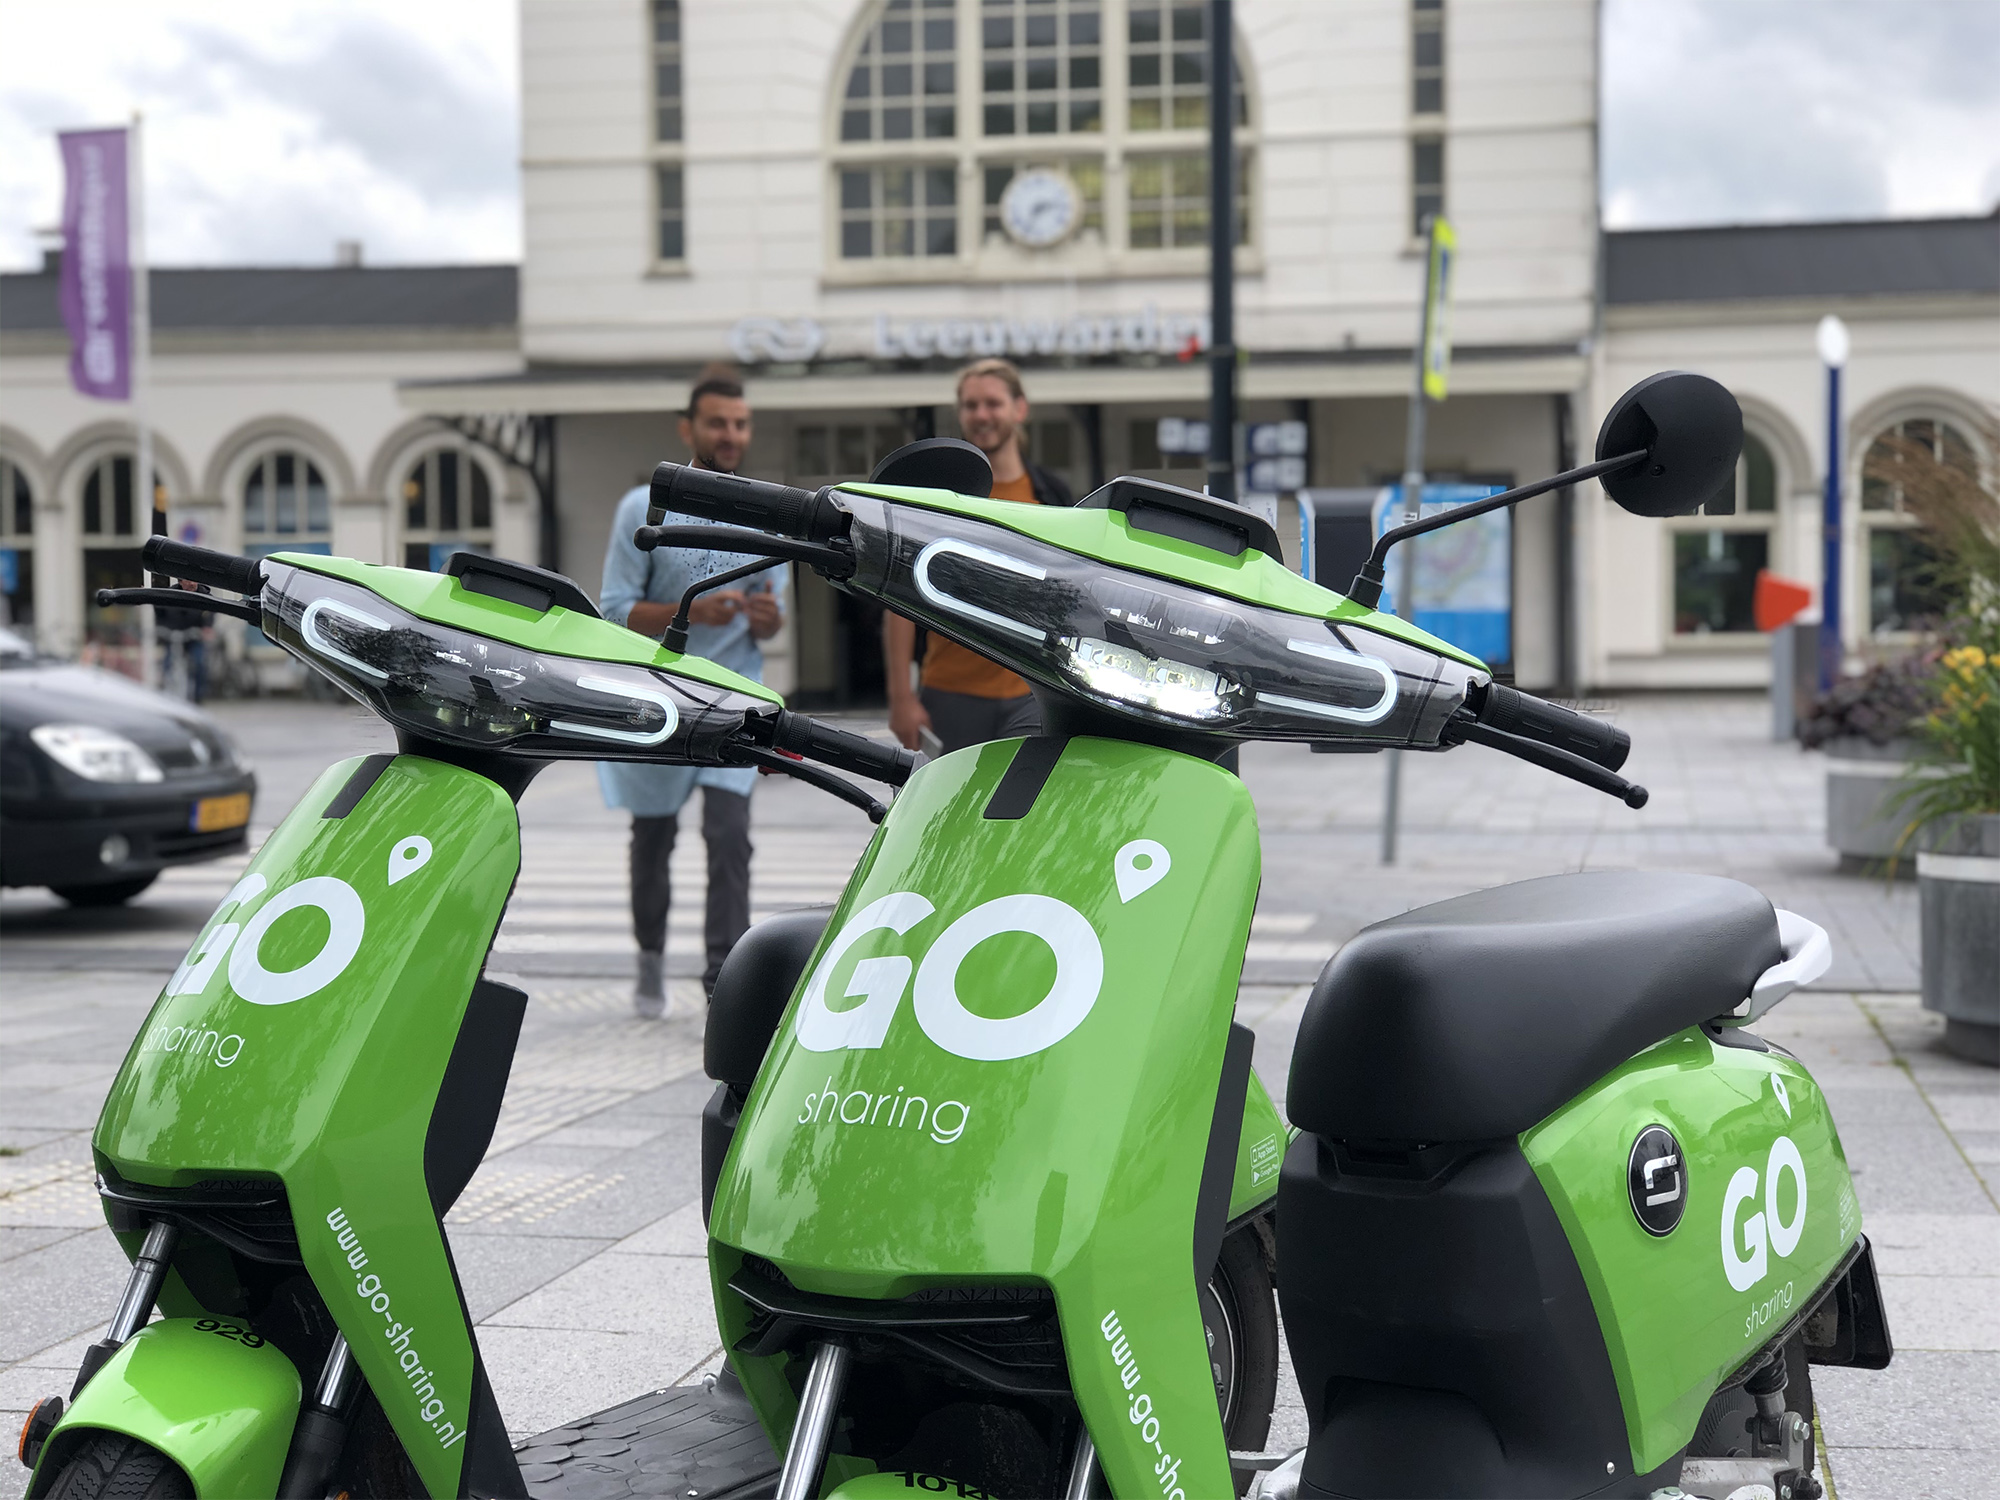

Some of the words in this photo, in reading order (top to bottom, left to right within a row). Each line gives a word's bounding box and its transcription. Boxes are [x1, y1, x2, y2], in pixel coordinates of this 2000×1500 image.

[166, 873, 365, 1005] GO
[796, 892, 1104, 1061] GO
[143, 1015, 245, 1067] sharing
[798, 1076, 970, 1144] sharing
[1721, 1136, 1807, 1292] GO
[193, 1319, 265, 1348] 929
[326, 1207, 467, 1449] www.go-sharing.nl
[1744, 1281, 1793, 1338] sharing
